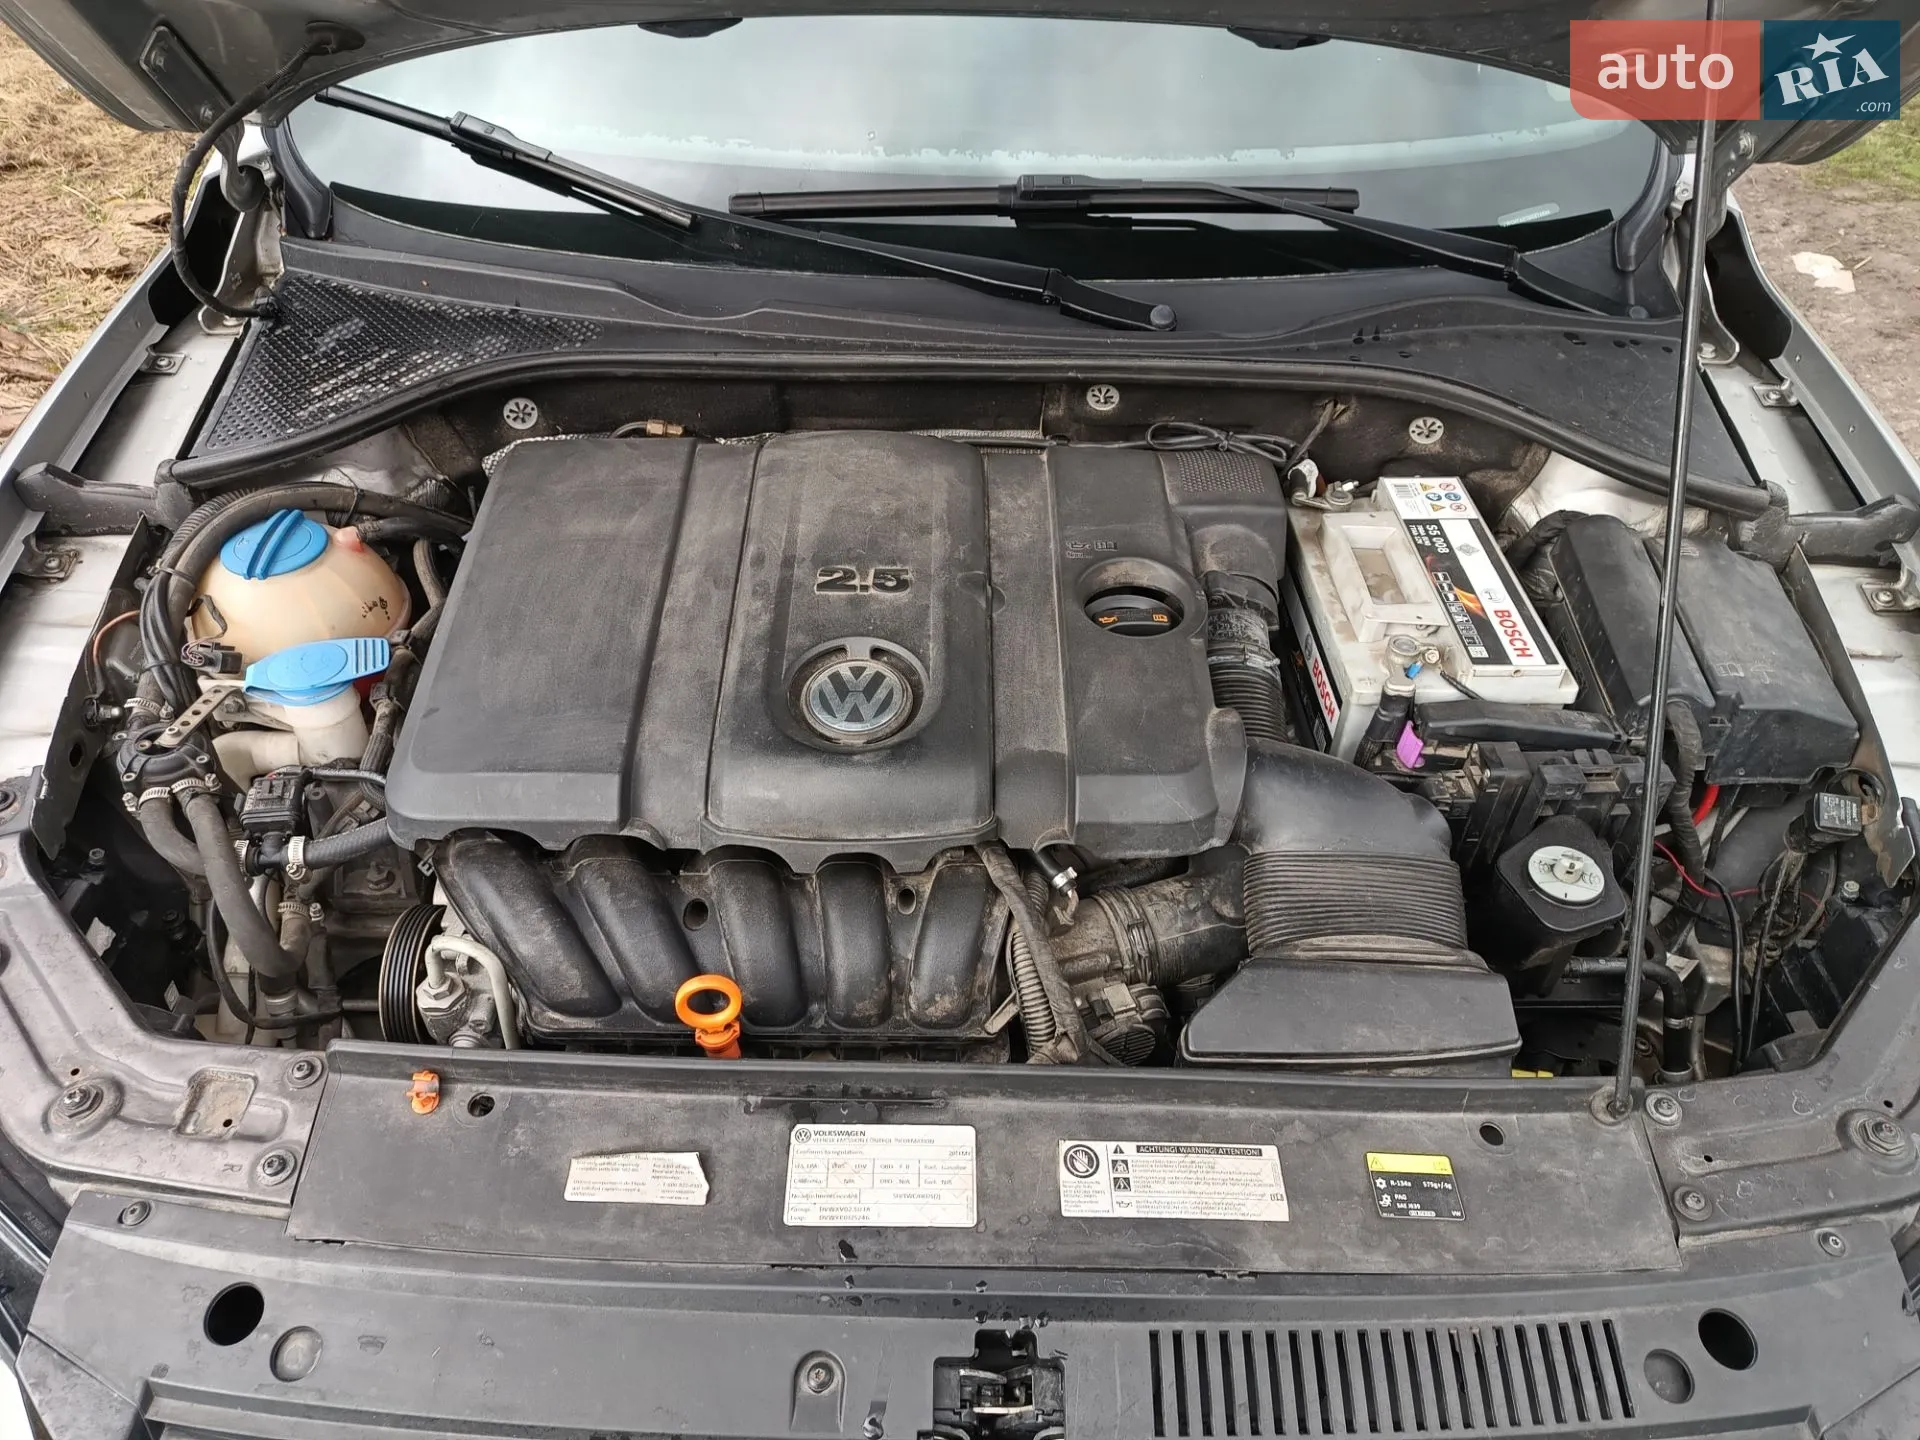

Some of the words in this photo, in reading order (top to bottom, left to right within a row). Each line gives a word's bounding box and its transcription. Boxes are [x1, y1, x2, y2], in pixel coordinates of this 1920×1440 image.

[1432, 537, 1449, 554] 008
[815, 565, 912, 594] 2.5
[1493, 609, 1534, 657] BOSCH
[1312, 657, 1336, 722] BOSCH
[1139, 1145, 1178, 1153] ACHTUNG!
[1179, 1146, 1217, 1155] WARNING!
[1218, 1148, 1260, 1156] ATTENTION!
